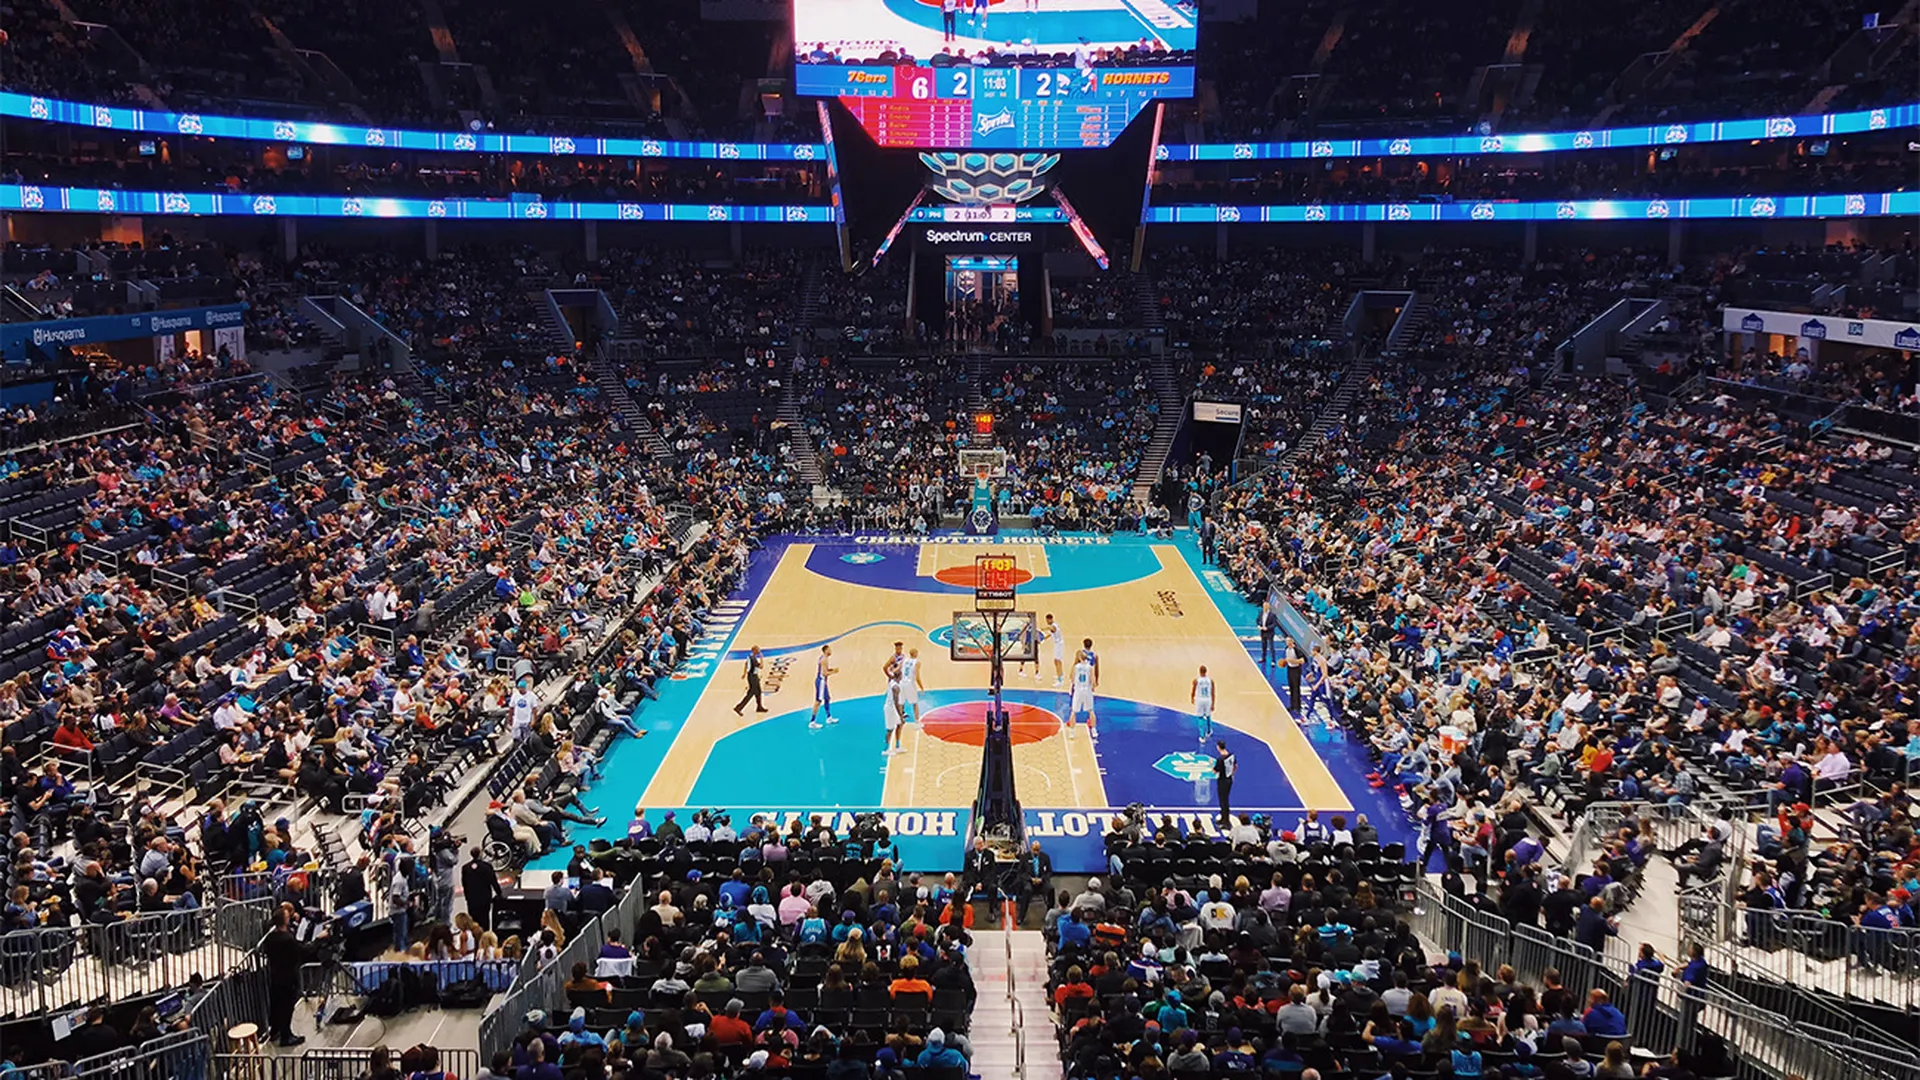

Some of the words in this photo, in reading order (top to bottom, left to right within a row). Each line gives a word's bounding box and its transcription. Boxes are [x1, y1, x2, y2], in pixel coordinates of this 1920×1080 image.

[847, 70, 887, 83] 76ers
[952, 72, 968, 95] 2
[1102, 72, 1170, 85] HORNETS
[912, 77, 928, 99] 6
[1036, 73, 1051, 96] 2
[977, 112, 1011, 133] Sprite
[926, 229, 985, 244] Spectrum
[989, 232, 1032, 242] CENTER
[42, 328, 85, 342] Husqvarna
[855, 536, 987, 545] CHARLOTTE
[1003, 536, 1112, 545] HORNETS
